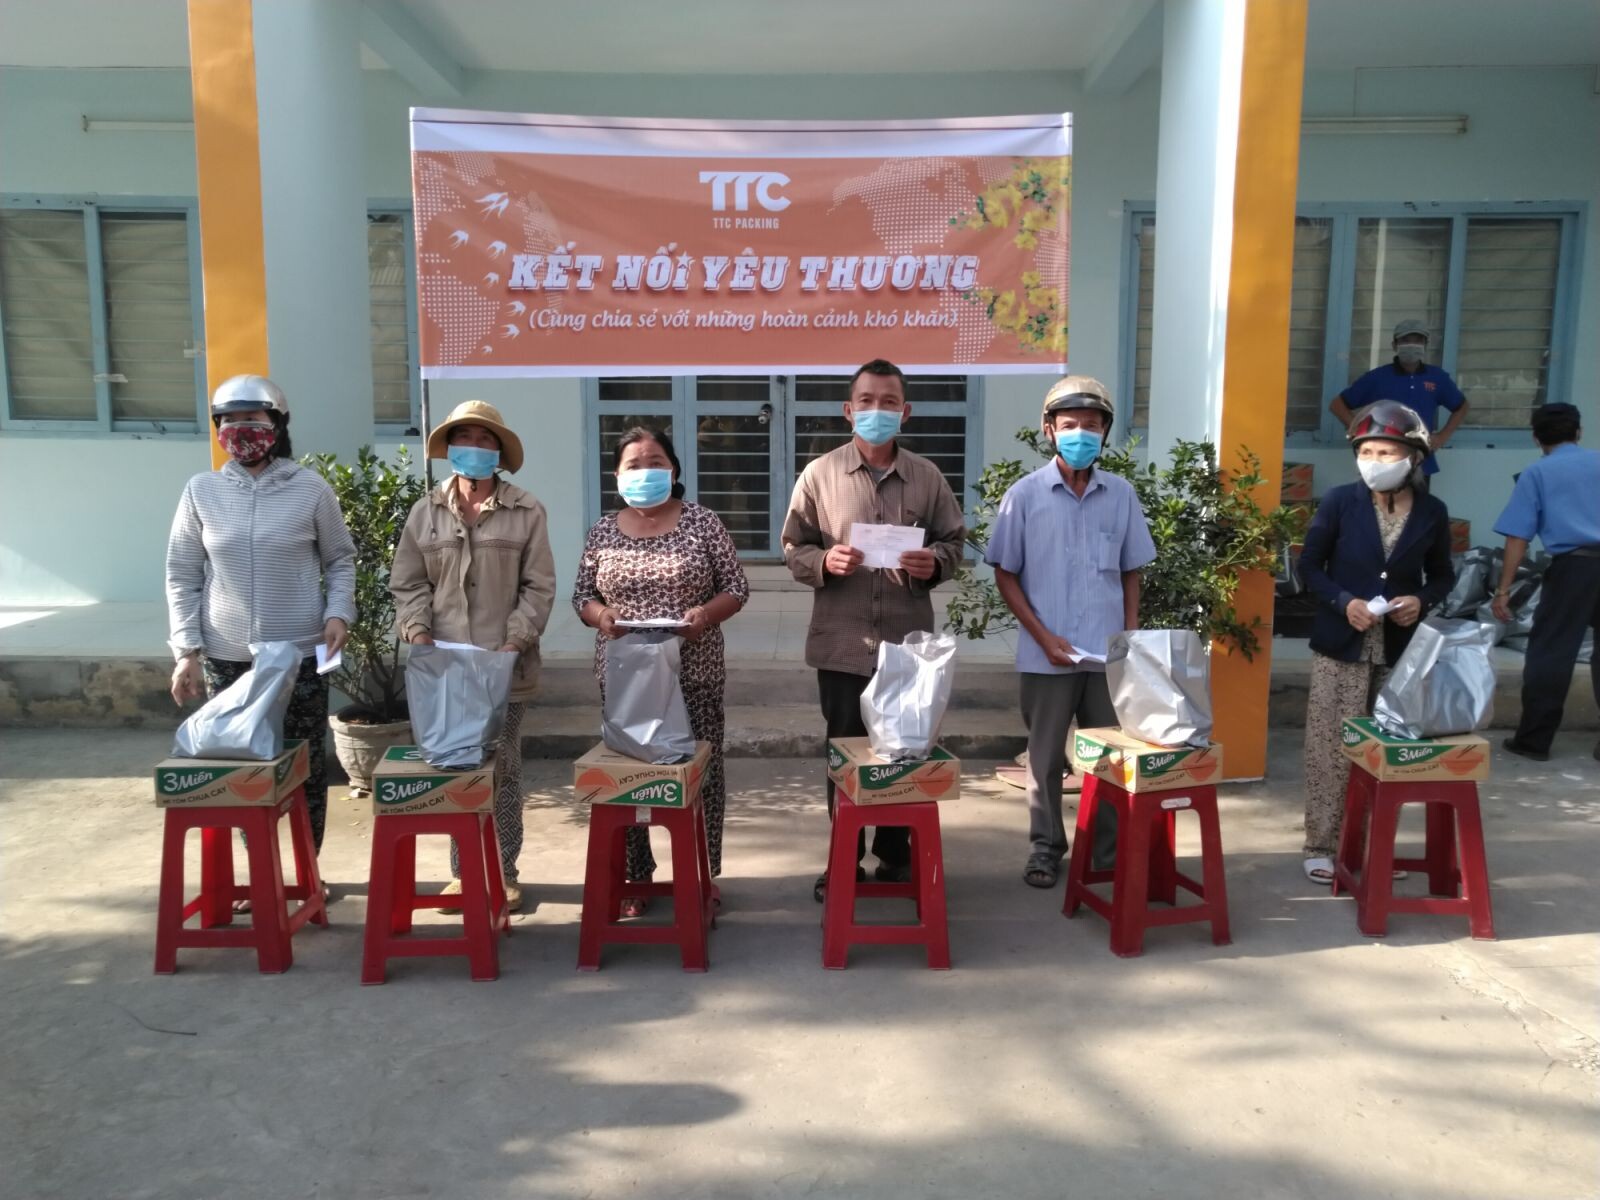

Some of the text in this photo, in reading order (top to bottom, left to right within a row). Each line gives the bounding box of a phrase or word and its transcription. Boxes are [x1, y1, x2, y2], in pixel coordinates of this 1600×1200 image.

[699, 171, 791, 211] TTC
[713, 218, 779, 229] TTC PACKING
[508, 242, 603, 290] KẾT
[703, 247, 791, 291] YÊU
[800, 255, 978, 291] THƯƠNG
[529, 308, 958, 331] (Cùng chia sẻ với những hoàn cảnh khó khăn)
[619, 774, 634, 785] CAY
[635, 770, 655, 779] CHUA
[187, 793, 209, 802] CHUA
[210, 786, 227, 797] CAY
[405, 802, 428, 812] CHUA
[429, 795, 446, 807] CAY
